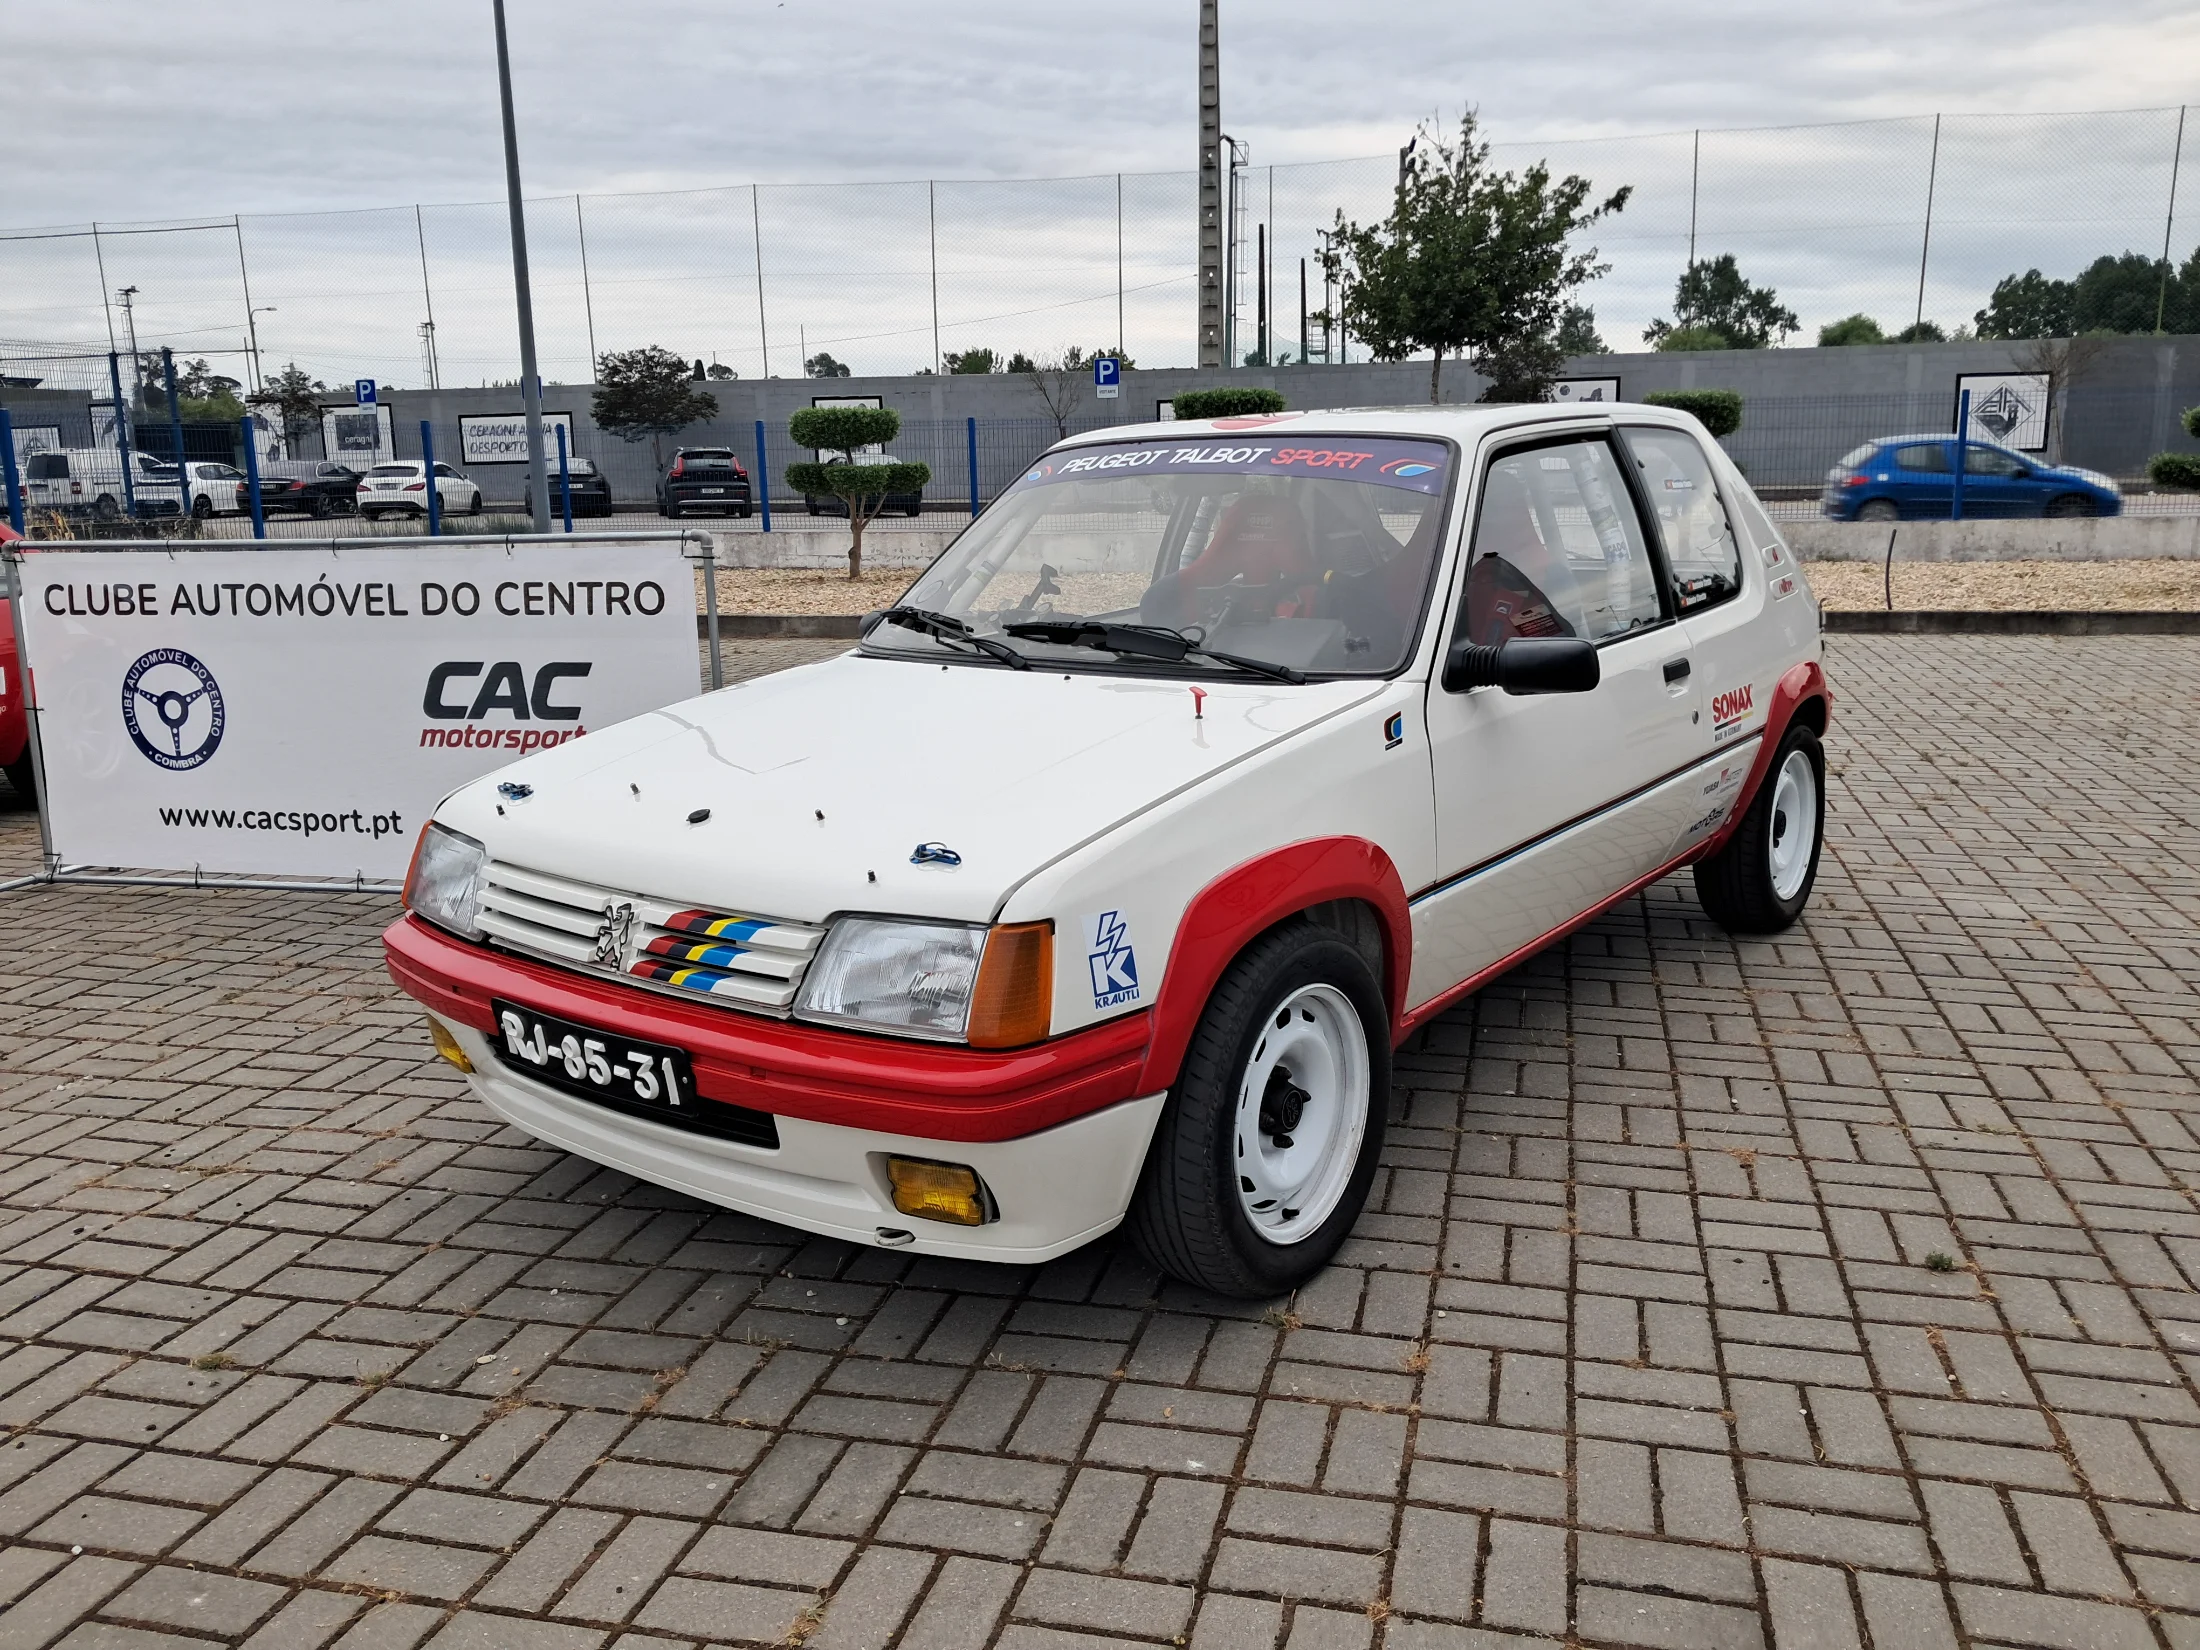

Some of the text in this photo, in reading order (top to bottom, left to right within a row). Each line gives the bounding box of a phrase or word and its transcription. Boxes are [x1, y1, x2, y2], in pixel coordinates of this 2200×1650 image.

[1099, 360, 1114, 384] P
[359, 381, 372, 401] P
[1057, 447, 1374, 475] PEUGEOT TALBOT SPORT
[43, 572, 666, 617] CLUBE AUTOMÓVEL DO CENTRO
[123, 649, 222, 737] CLUBE AUTOMÓVEL DO CENTRO
[423, 661, 593, 720] CAC
[1713, 683, 1753, 723] SONAX
[419, 724, 587, 755] motorsport
[154, 753, 204, 769] COIMBRA
[158, 807, 404, 840] www.cacsport.pt
[1094, 988, 1140, 1010] KRAUTLI
[501, 1010, 681, 1106] RJ-85-31
